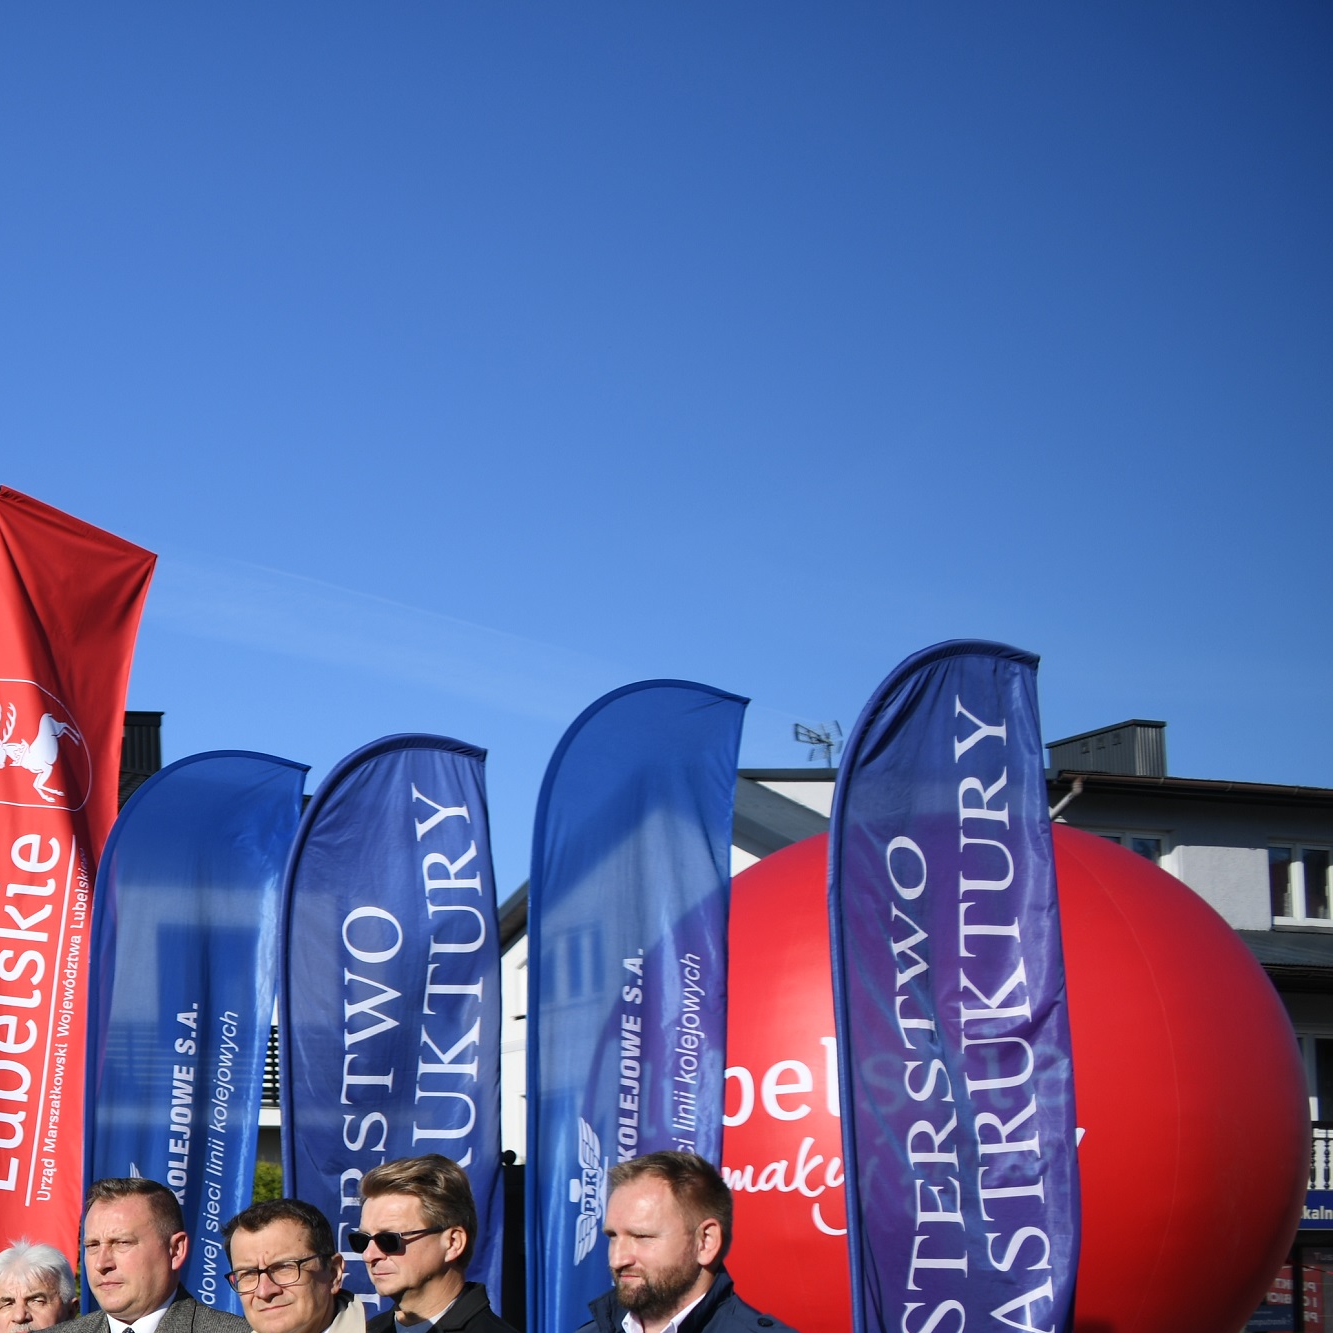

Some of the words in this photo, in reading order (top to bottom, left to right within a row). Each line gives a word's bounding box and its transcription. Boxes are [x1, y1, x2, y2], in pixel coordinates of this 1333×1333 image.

[57, 934, 82, 1038] Województwa
[622, 948, 644, 1005] S.A.
[174, 1002, 200, 1056] S.A.
[675, 952, 706, 1085] kolejowych
[44, 1042, 68, 1154] Marszałkowski
[210, 1010, 240, 1135] kolejowych
[673, 1090, 696, 1134] linii
[37, 1157, 55, 1202] Urząd
[206, 1137, 226, 1177] linii
[203, 1180, 222, 1233] sieci
[583, 1171, 598, 1217] PLK
[197, 1240, 223, 1306] dowej
